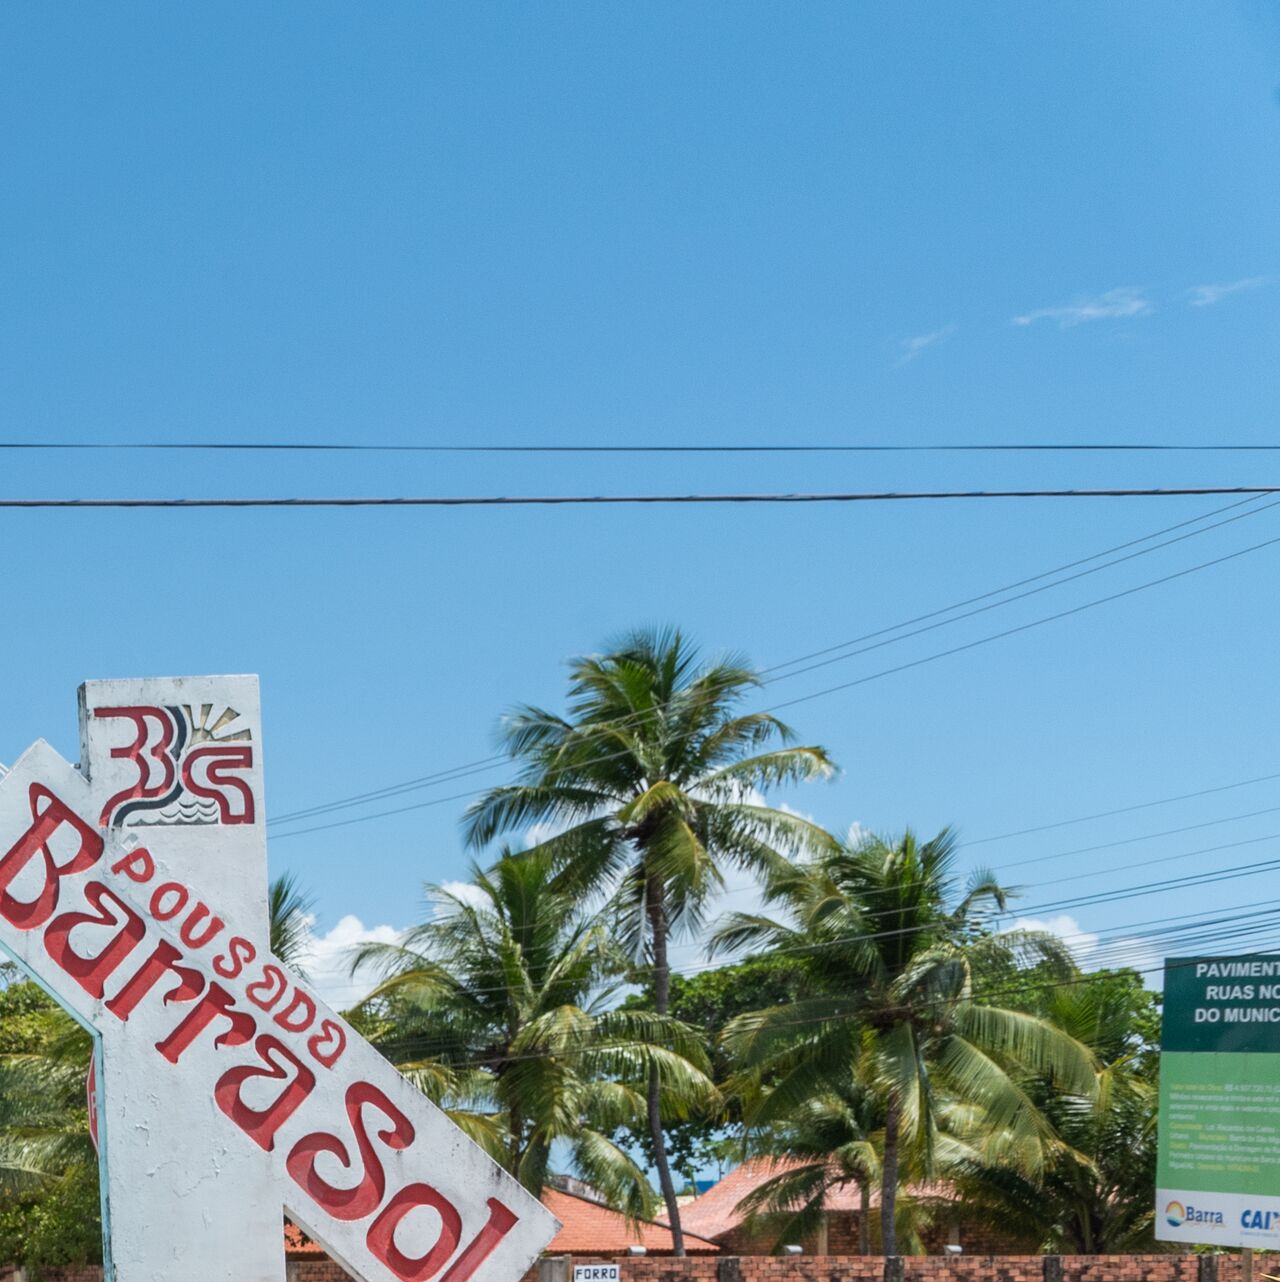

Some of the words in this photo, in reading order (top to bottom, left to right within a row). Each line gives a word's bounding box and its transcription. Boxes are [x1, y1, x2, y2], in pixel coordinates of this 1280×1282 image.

[1205, 985, 1255, 1000] RUAS
[1194, 1007, 1220, 1023] DO
[1185, 1206, 1224, 1224] Barra
[576, 1268, 616, 1280] FORRO
